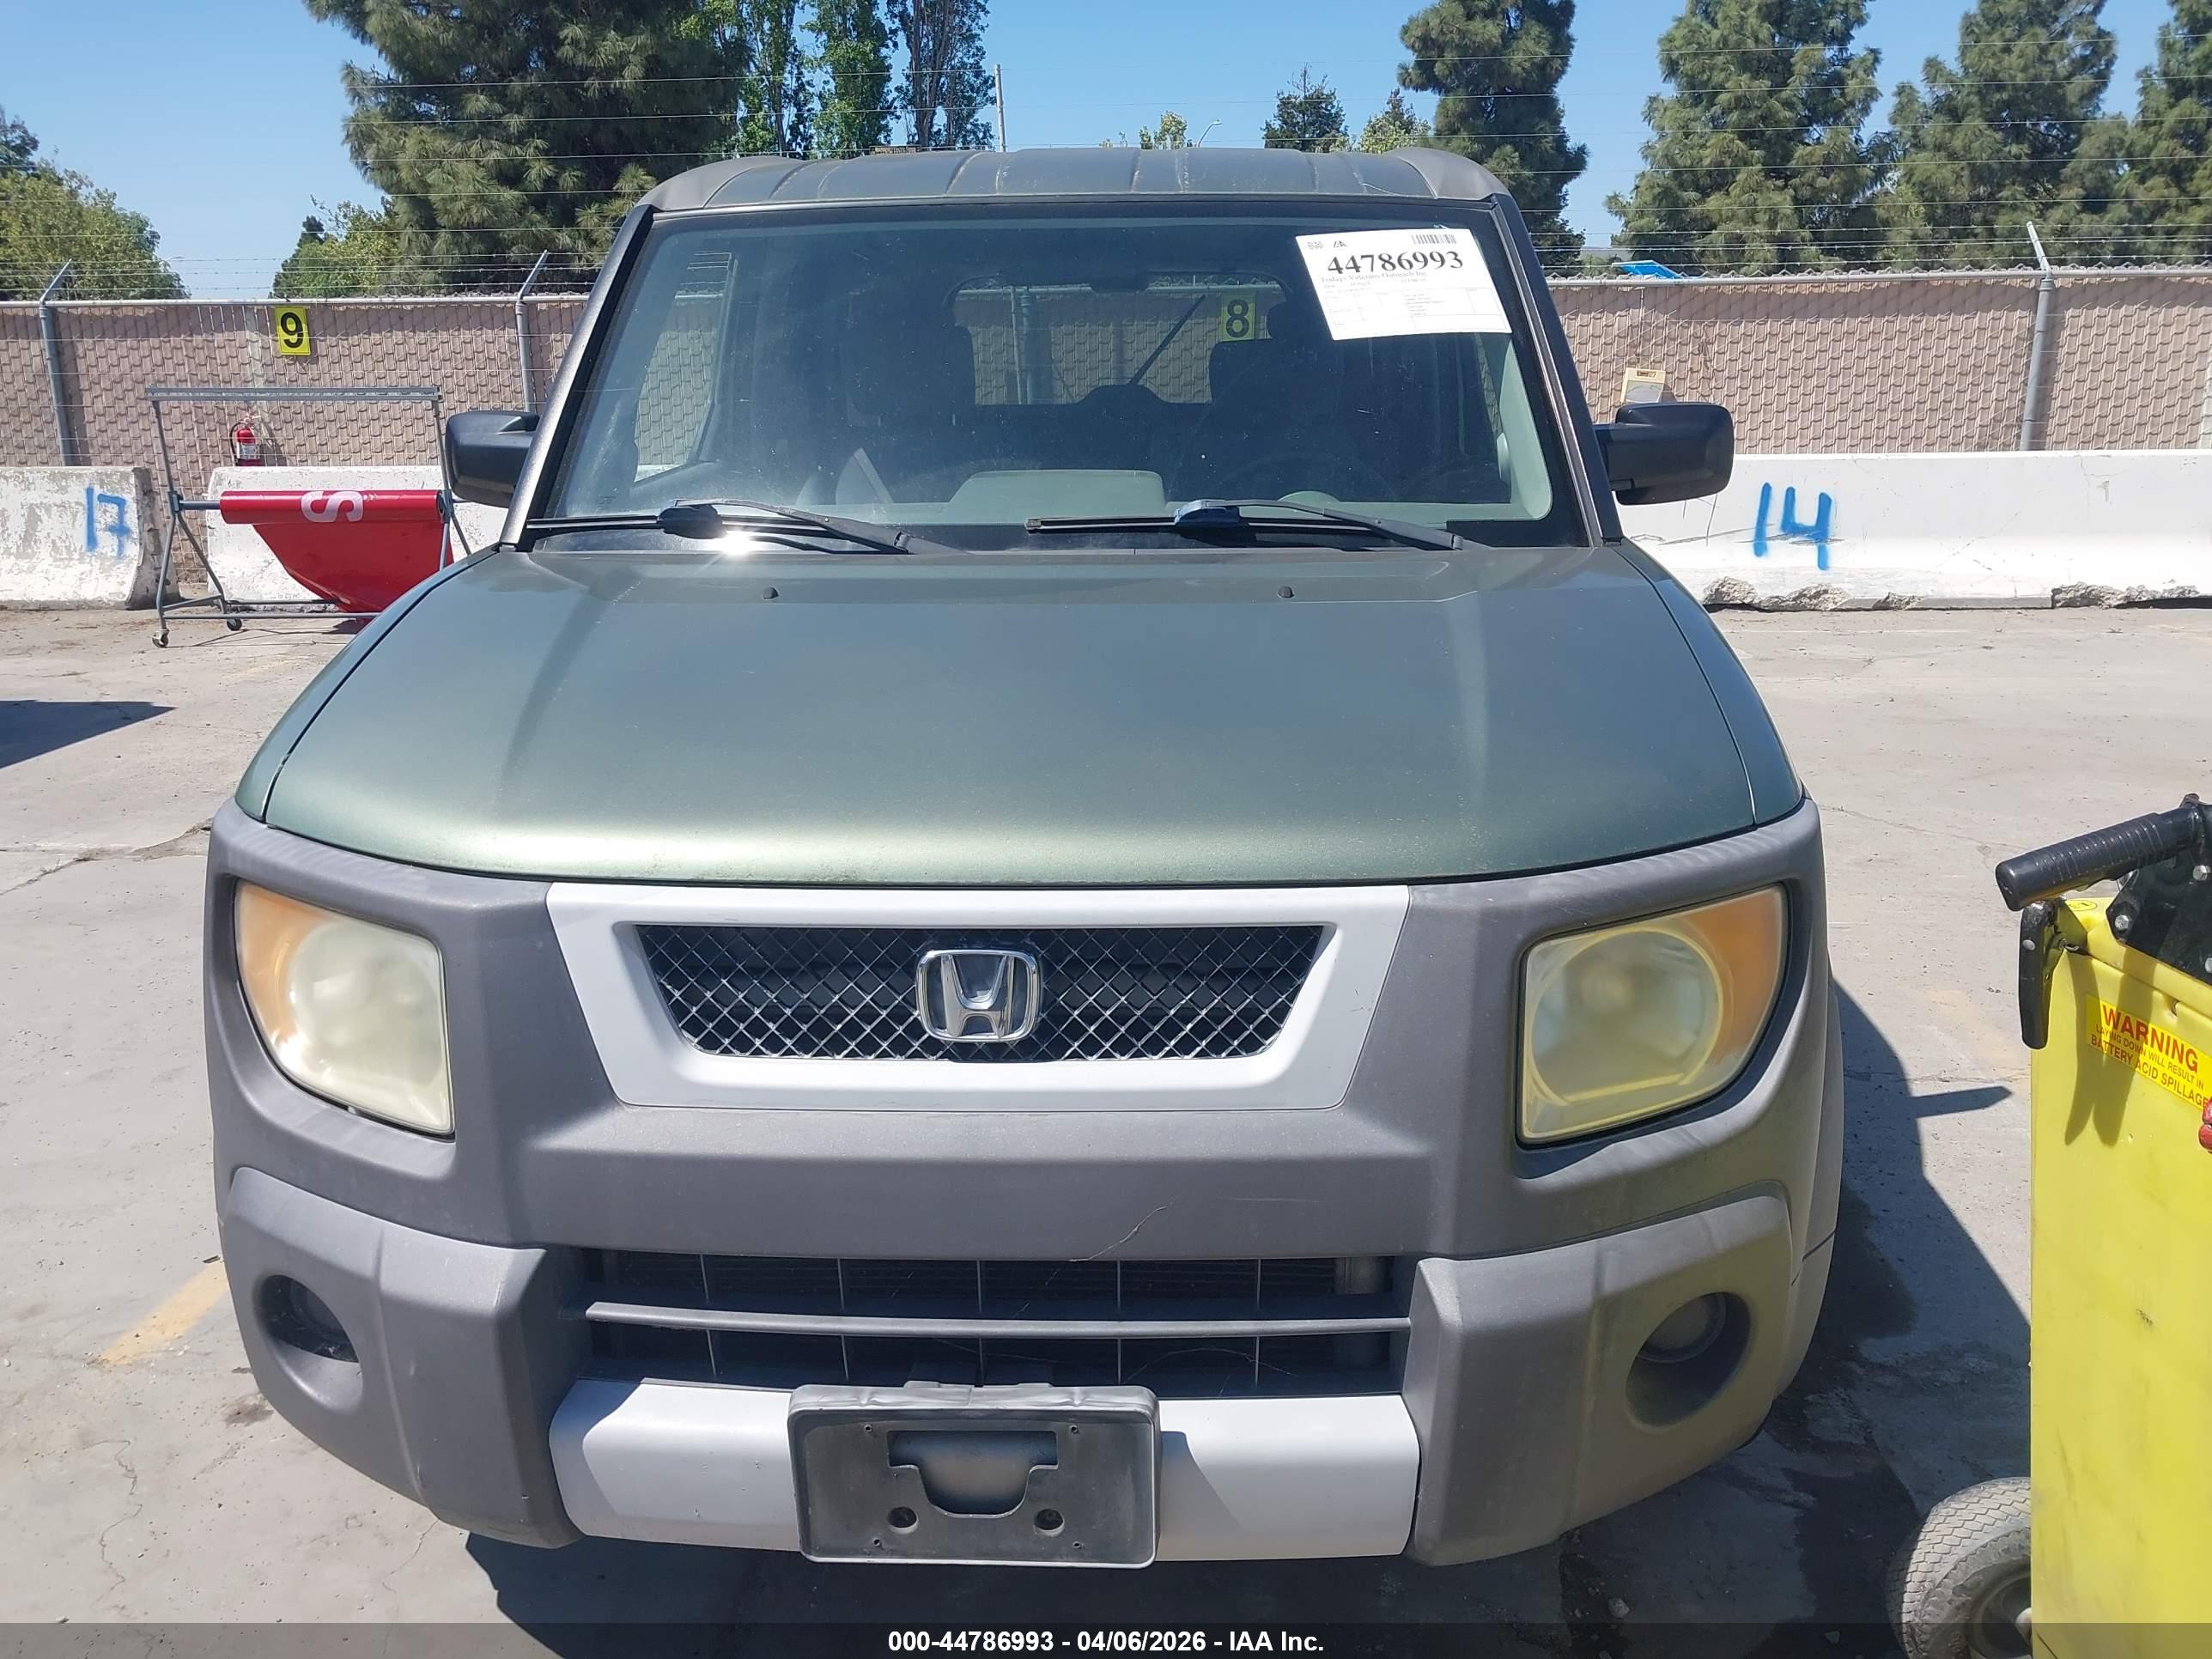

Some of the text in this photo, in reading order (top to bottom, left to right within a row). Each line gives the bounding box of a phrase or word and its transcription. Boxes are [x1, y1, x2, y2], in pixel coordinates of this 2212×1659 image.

[1328, 251, 1463, 274] 44786993
[281, 312, 304, 349] 9
[1225, 299, 1249, 338] 8
[1753, 482, 1832, 571] 14
[2091, 1034, 2134, 1065] BATTERY
[2136, 1059, 2159, 1079] ACID
[2096, 1024, 2204, 1091] LAYING DOWN WILL RESULT IN
[2102, 1004, 2198, 1073] WARNING
